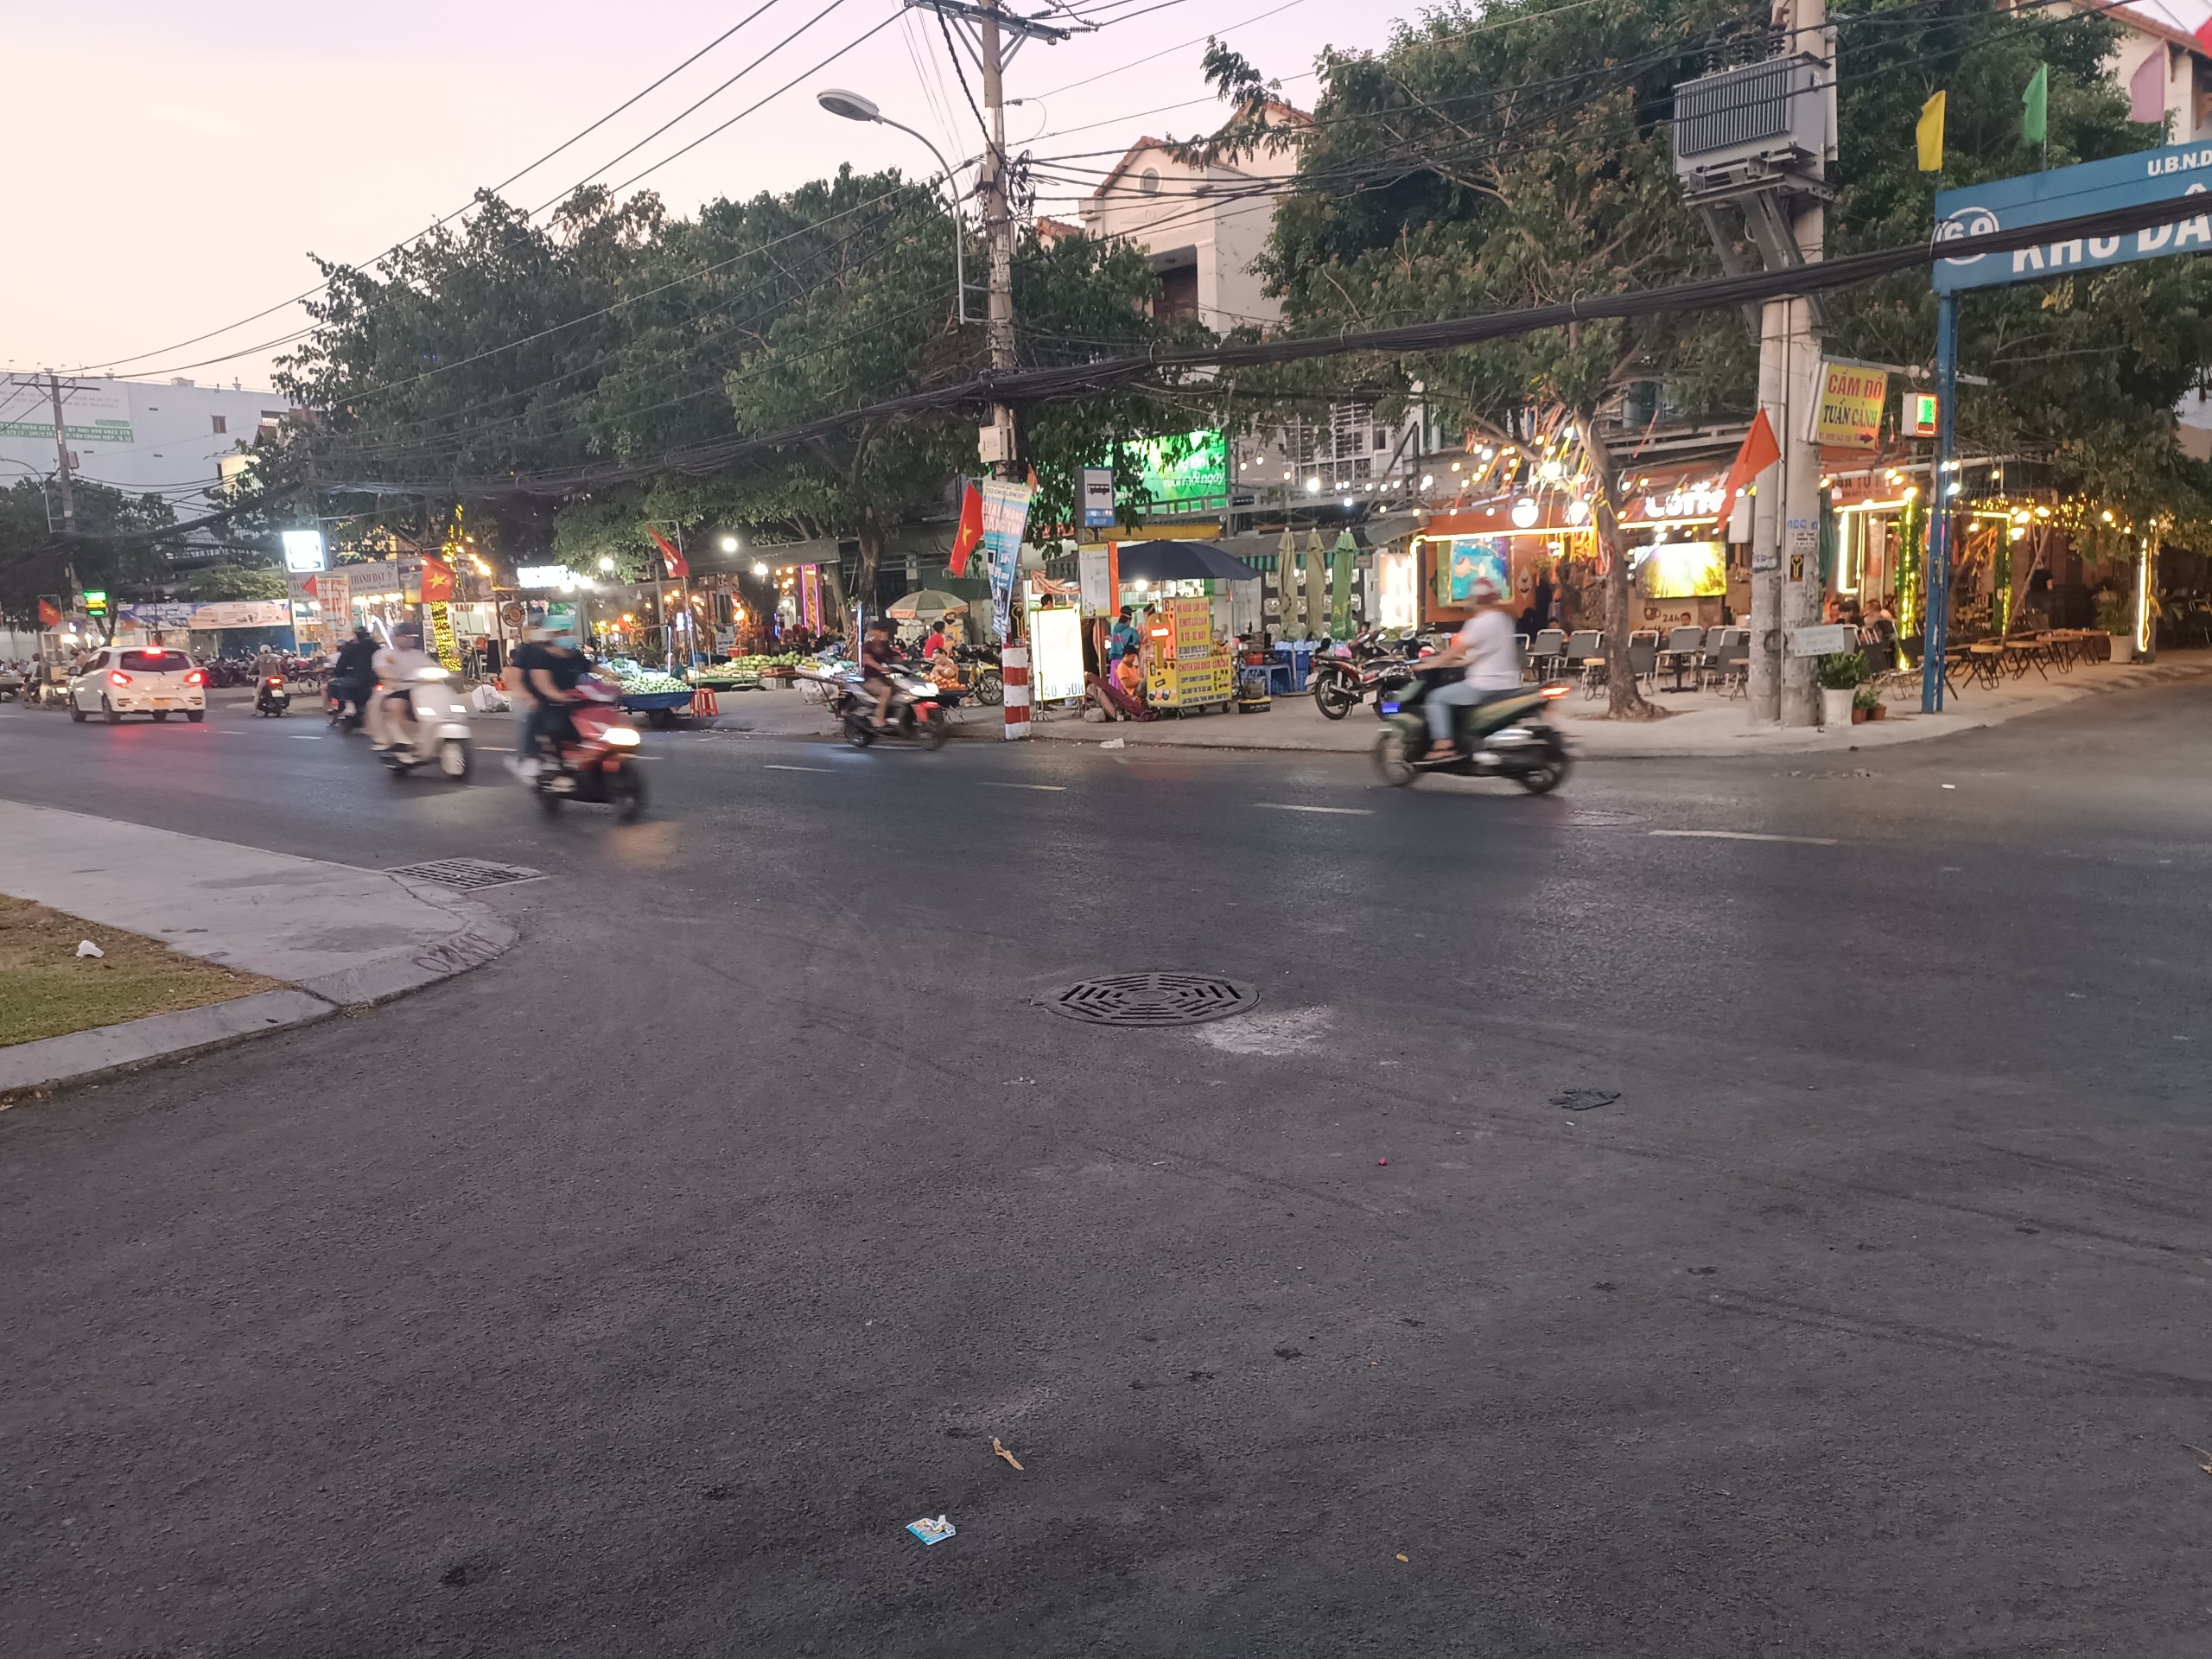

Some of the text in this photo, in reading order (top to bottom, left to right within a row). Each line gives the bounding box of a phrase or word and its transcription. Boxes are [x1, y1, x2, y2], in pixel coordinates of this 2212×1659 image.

[1827, 369, 1884, 399] CẦM ĐỒ
[1823, 397, 1851, 424] TUẤN
[1662, 613, 1680, 623] 24h
